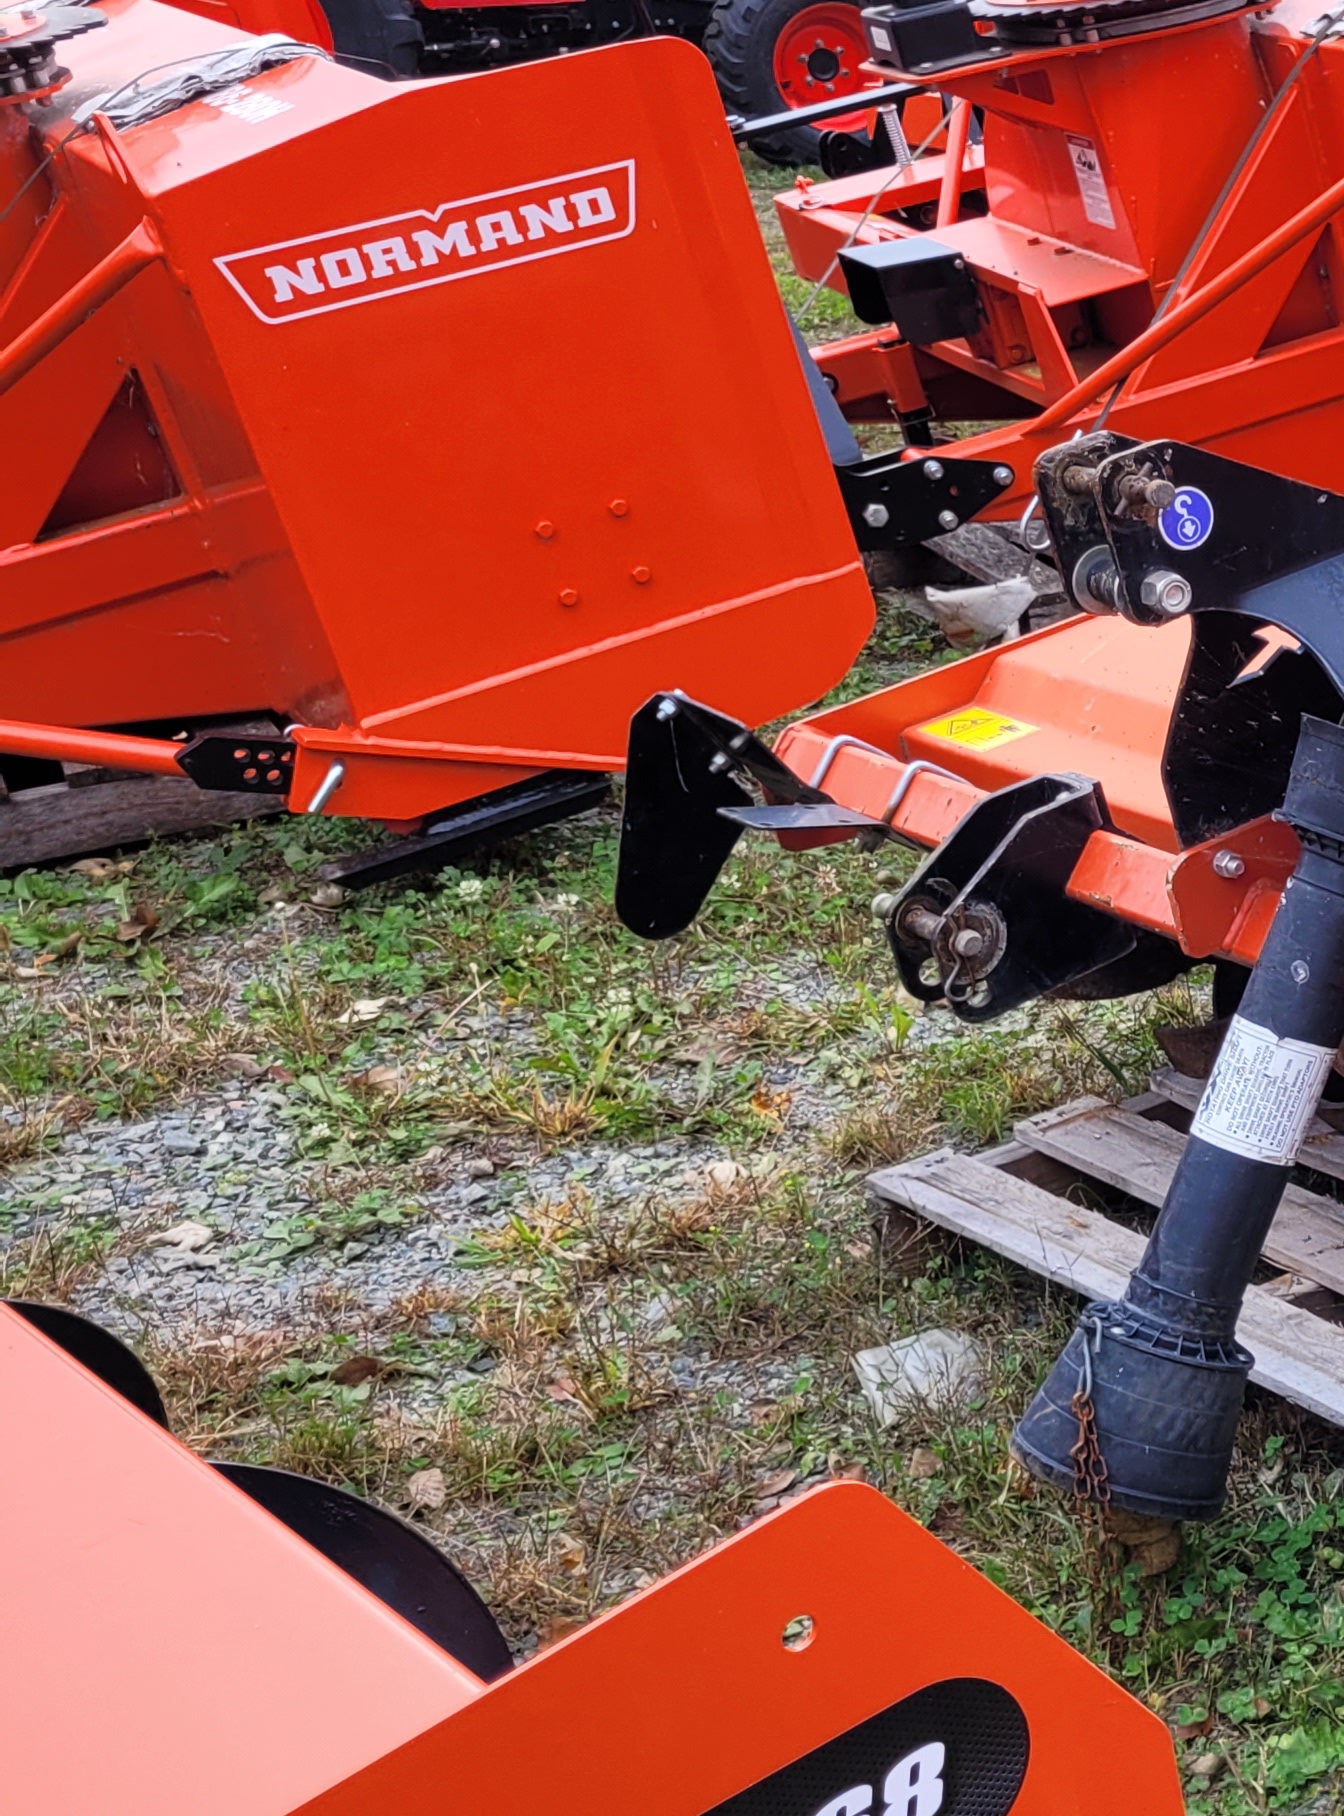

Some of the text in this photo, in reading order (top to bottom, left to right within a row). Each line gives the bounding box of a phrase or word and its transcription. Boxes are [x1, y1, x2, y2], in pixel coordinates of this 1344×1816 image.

[264, 186, 616, 303] NORMAND
[1223, 1056, 1250, 1113] KEEP AWAY!
[1295, 1059, 1313, 1095] ADAPTORS
